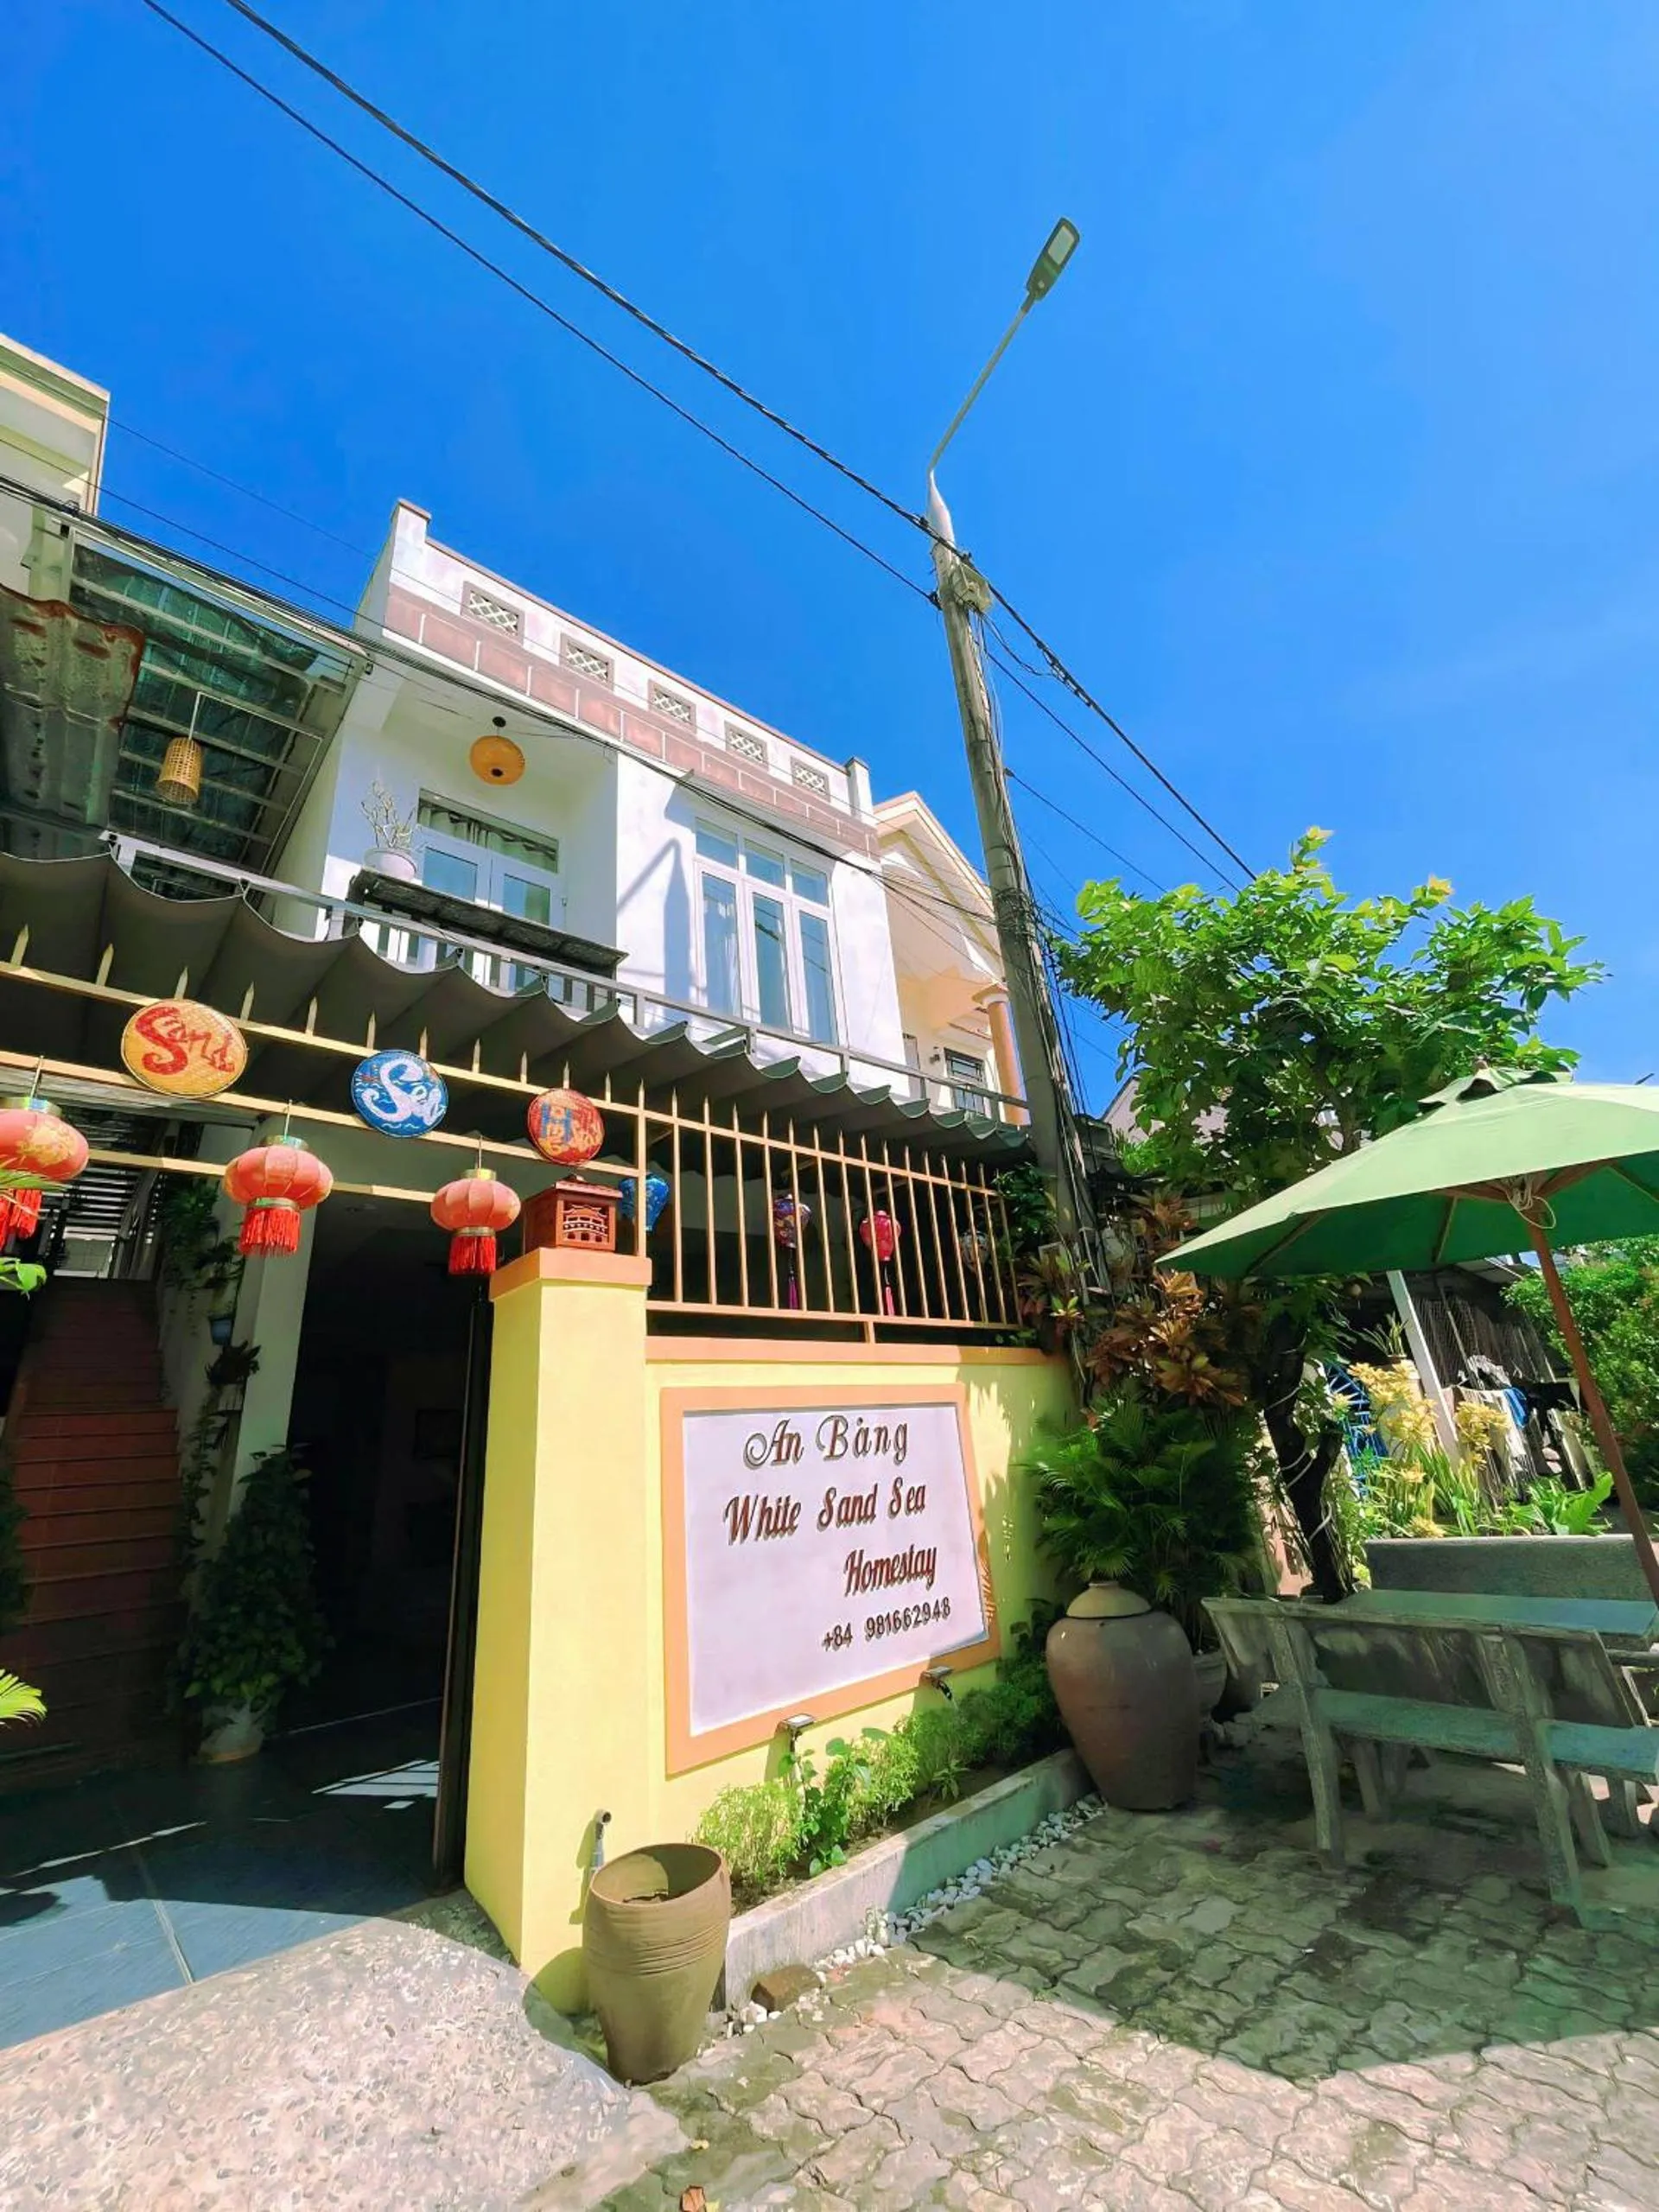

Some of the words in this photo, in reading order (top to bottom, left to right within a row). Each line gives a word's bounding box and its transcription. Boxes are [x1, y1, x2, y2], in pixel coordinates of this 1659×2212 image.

[361, 1058, 446, 1126] Sea
[743, 1418, 804, 1469] An
[723, 1495, 802, 1545] White
[817, 1483, 879, 1532] Sand
[888, 1477, 926, 1519] Sea
[843, 1544, 938, 1597] Homestay
[822, 1623, 854, 1652] +84
[864, 1597, 950, 1642] 981662948
